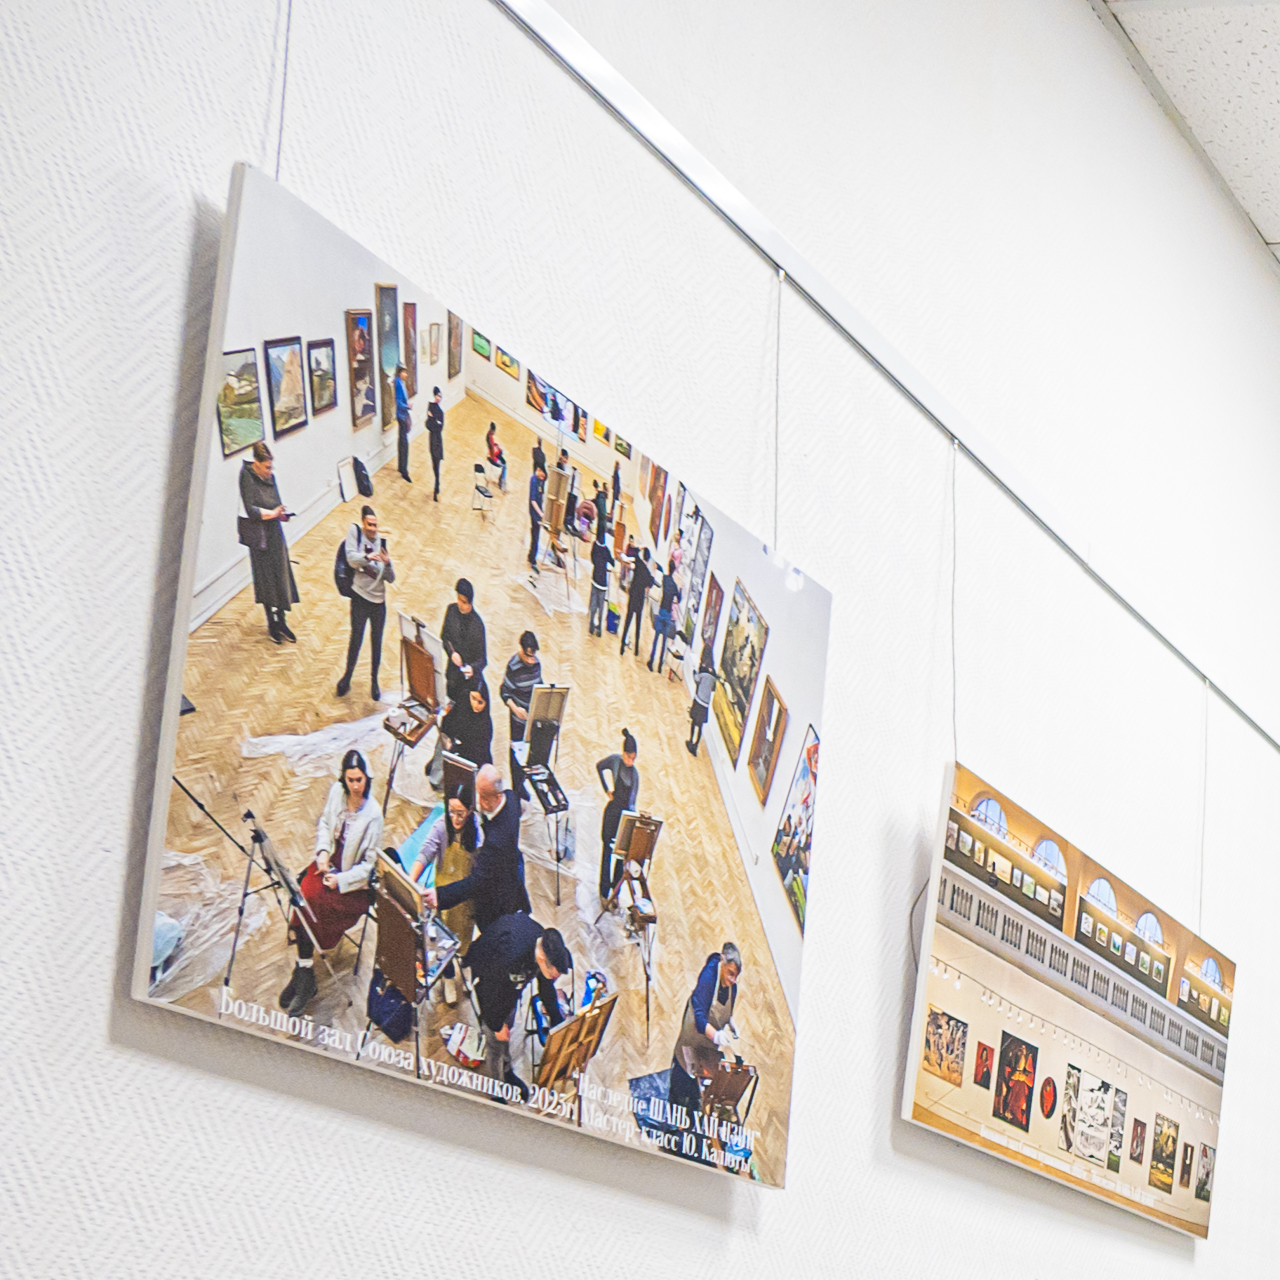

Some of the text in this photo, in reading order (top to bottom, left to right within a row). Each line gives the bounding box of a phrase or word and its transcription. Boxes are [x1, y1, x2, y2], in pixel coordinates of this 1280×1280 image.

[220, 985, 315, 1040] Большой
[319, 1025, 352, 1052] зал
[356, 1029, 415, 1071] Союза
[419, 1055, 525, 1106] художников.
[581, 1103, 680, 1152] Мастер-класс
[682, 1132, 699, 1157] Ю.
[702, 1140, 752, 1173] Калюты
[649, 1096, 690, 1130] ШАНЬ
